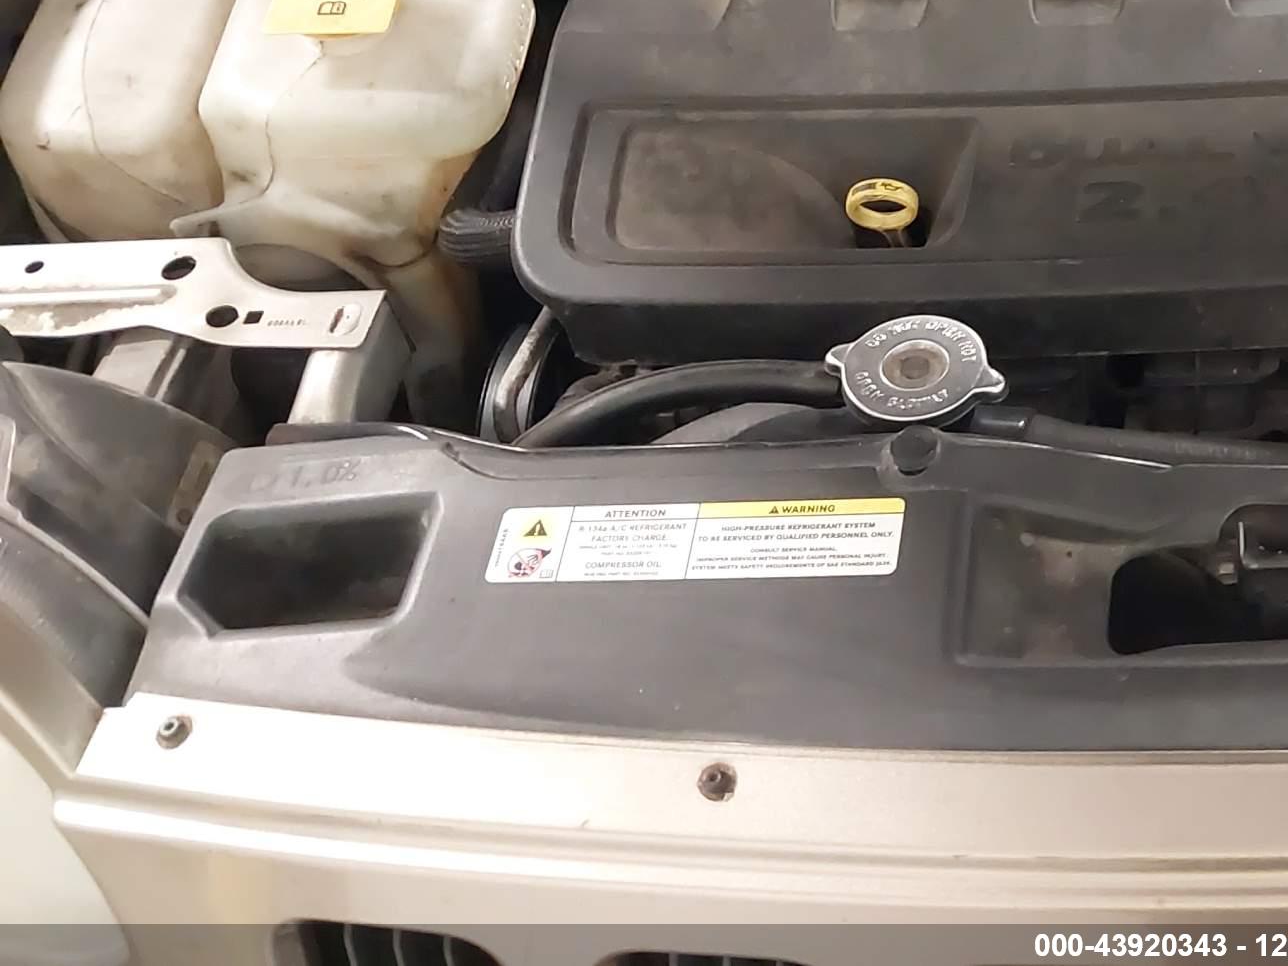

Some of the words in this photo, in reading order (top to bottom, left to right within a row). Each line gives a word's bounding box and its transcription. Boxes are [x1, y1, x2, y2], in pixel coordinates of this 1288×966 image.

[604, 509, 667, 518] ATTENTION
[782, 505, 836, 514] WARNING
[629, 523, 687, 531] REFRIGERANT
[787, 522, 842, 530] REFRIGERANT
[844, 521, 876, 529] SYSTEM
